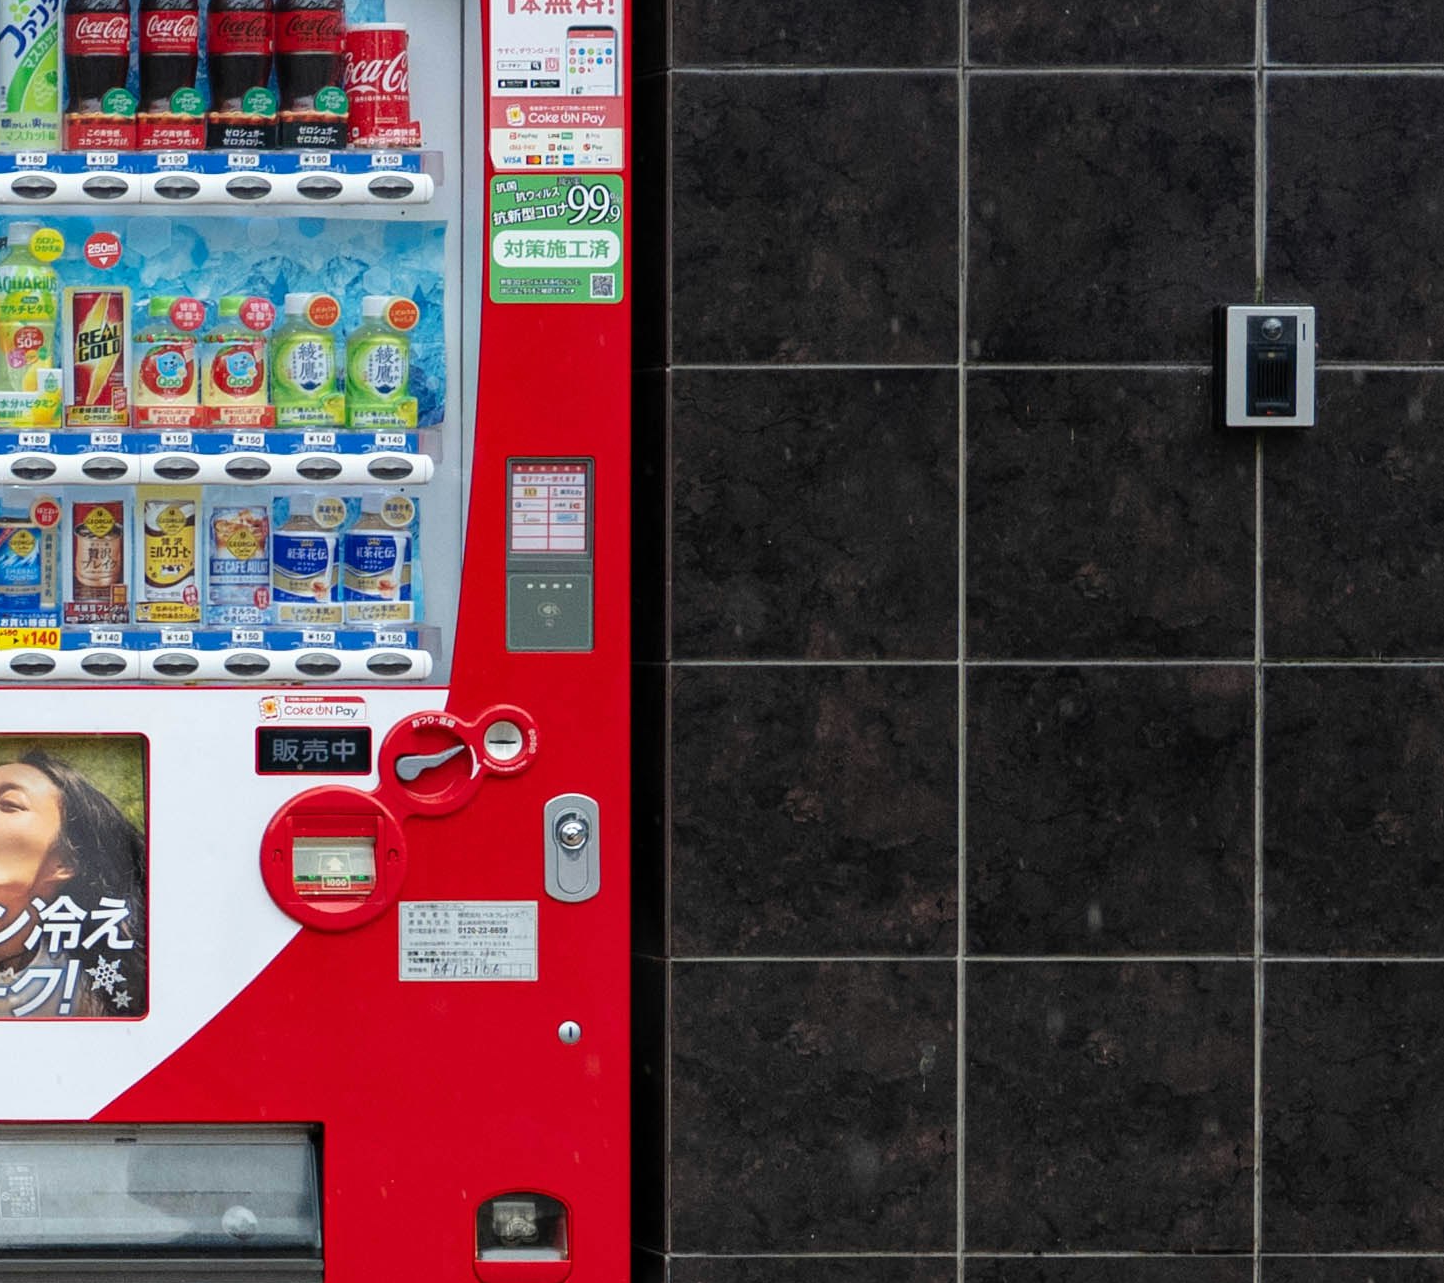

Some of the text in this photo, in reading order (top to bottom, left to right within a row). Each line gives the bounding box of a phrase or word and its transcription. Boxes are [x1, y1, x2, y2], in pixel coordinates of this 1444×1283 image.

[75, 15, 128, 40] Coca-Cola
[528, 111, 606, 126] Coke ON Pay
[503, 156, 521, 164] VISA
[493, 202, 568, 225] 抗新型コロナ
[87, 243, 119, 254] 250ml
[504, 240, 609, 258] 対策施工済
[0, 305, 55, 316] マルチビタミン
[78, 329, 121, 346] REAL
[78, 345, 120, 363] GOLD
[156, 375, 182, 387] Qoo
[227, 375, 254, 387] Qoo
[286, 548, 327, 560] 紅茶花伝
[82, 559, 117, 571] ブレイク
[272, 738, 357, 764] 販売中
[325, 877, 347, 887] 1000
